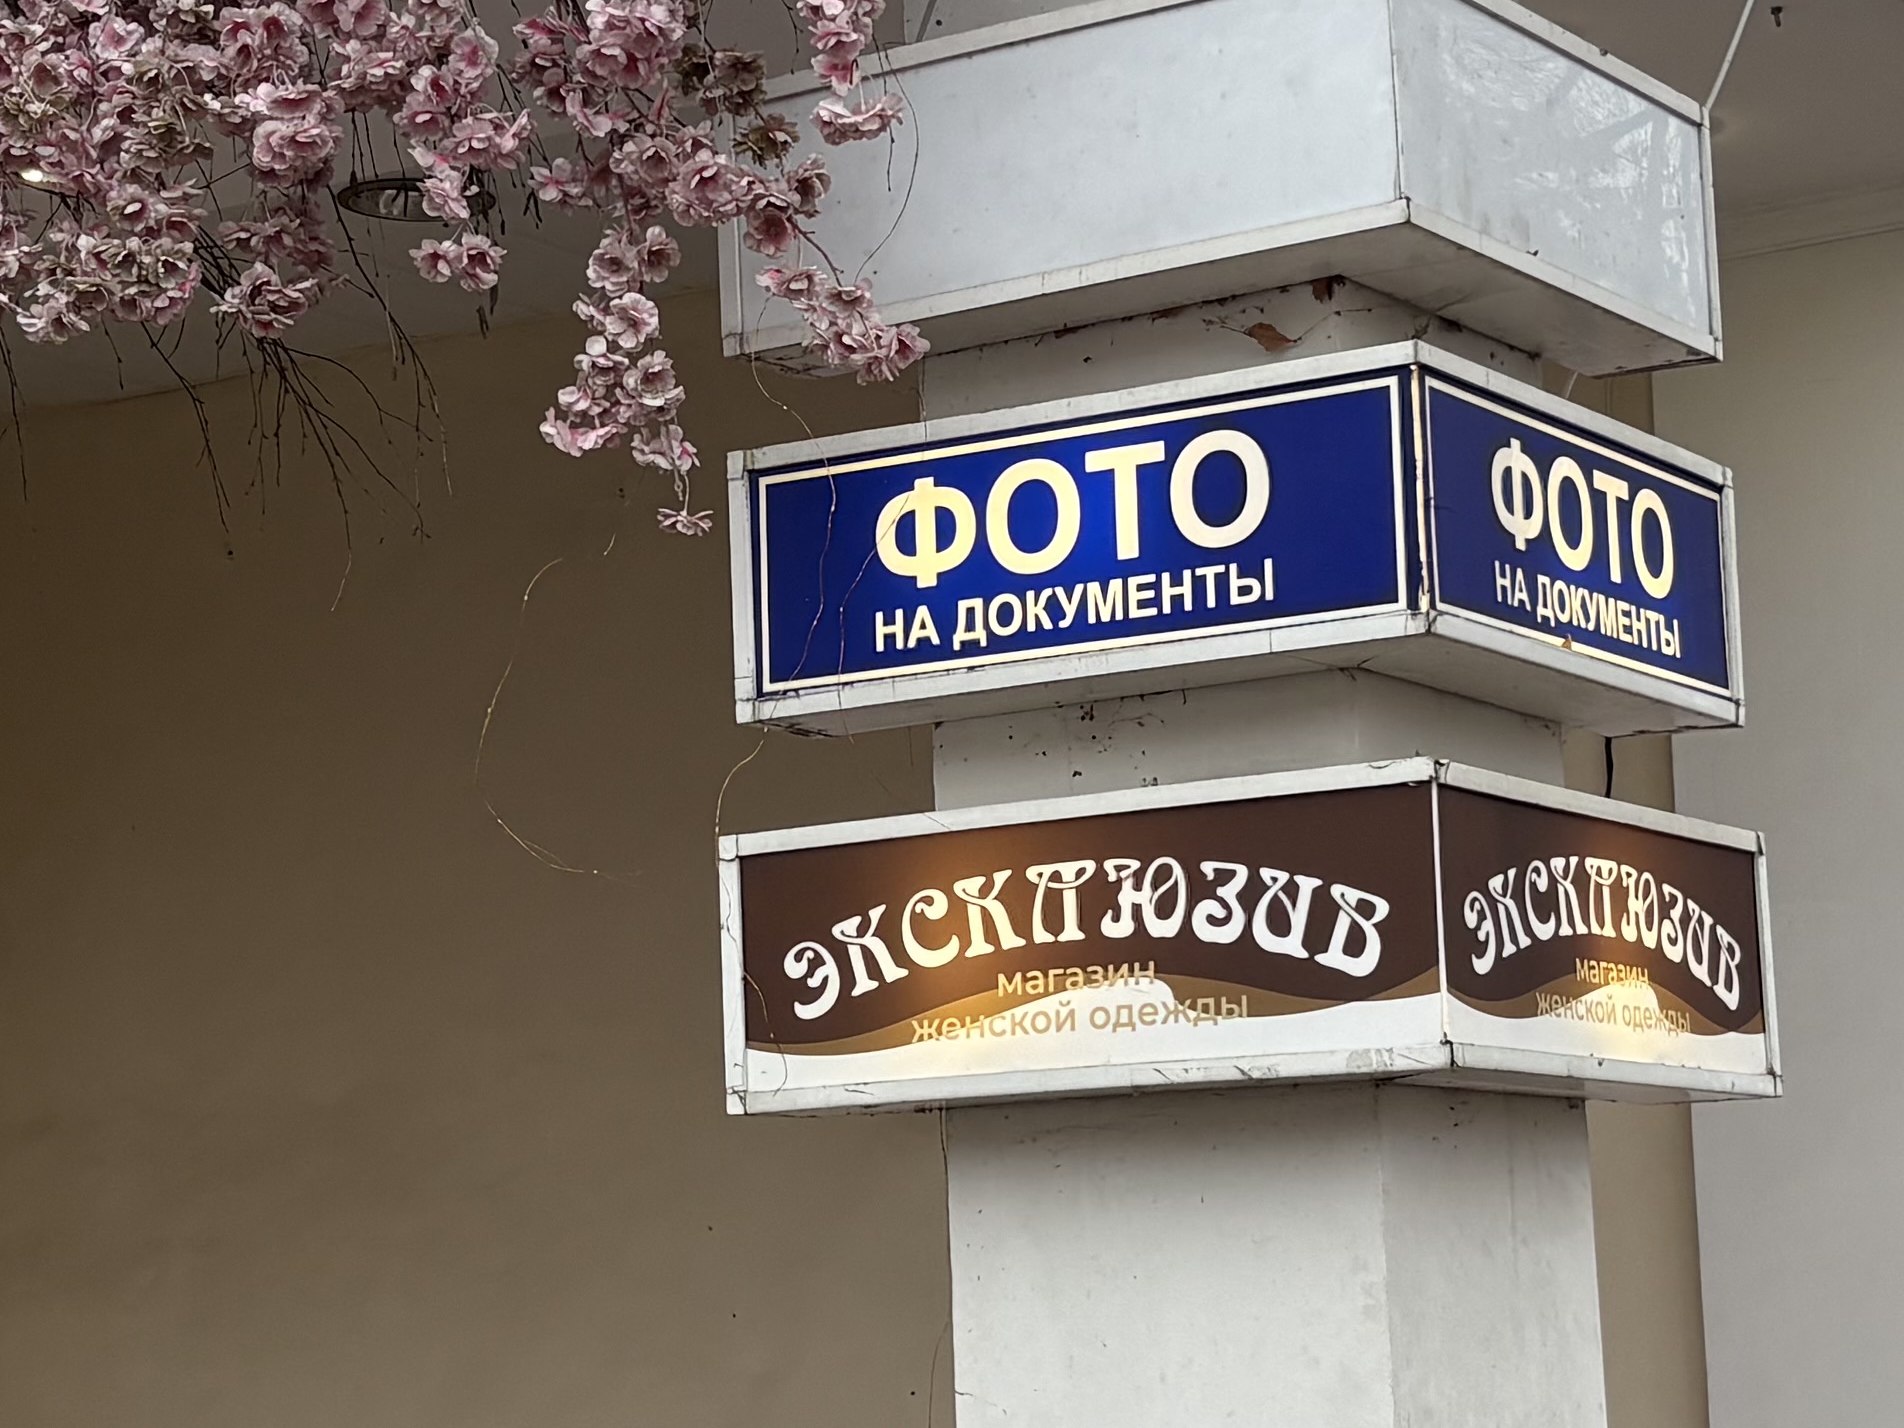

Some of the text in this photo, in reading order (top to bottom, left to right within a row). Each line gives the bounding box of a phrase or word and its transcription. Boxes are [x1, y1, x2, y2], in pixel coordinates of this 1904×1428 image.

[875, 429, 1270, 587] ФОТО
[1492, 438, 1675, 599] ФОТО
[874, 558, 1275, 653] НА ДОКУМЕНТЫ
[1494, 560, 1681, 659] НА ДОКУМЕНТЫ
[783, 856, 1390, 1020] ЭКСКЛЮЗИВ
[995, 958, 1157, 999] магазин
[1462, 855, 1742, 1012] ЭКСКЛЮЗИВ
[1574, 956, 1650, 989] магазин
[911, 992, 1249, 1044] женской одежды
[1535, 991, 1692, 1037] женской одежды
